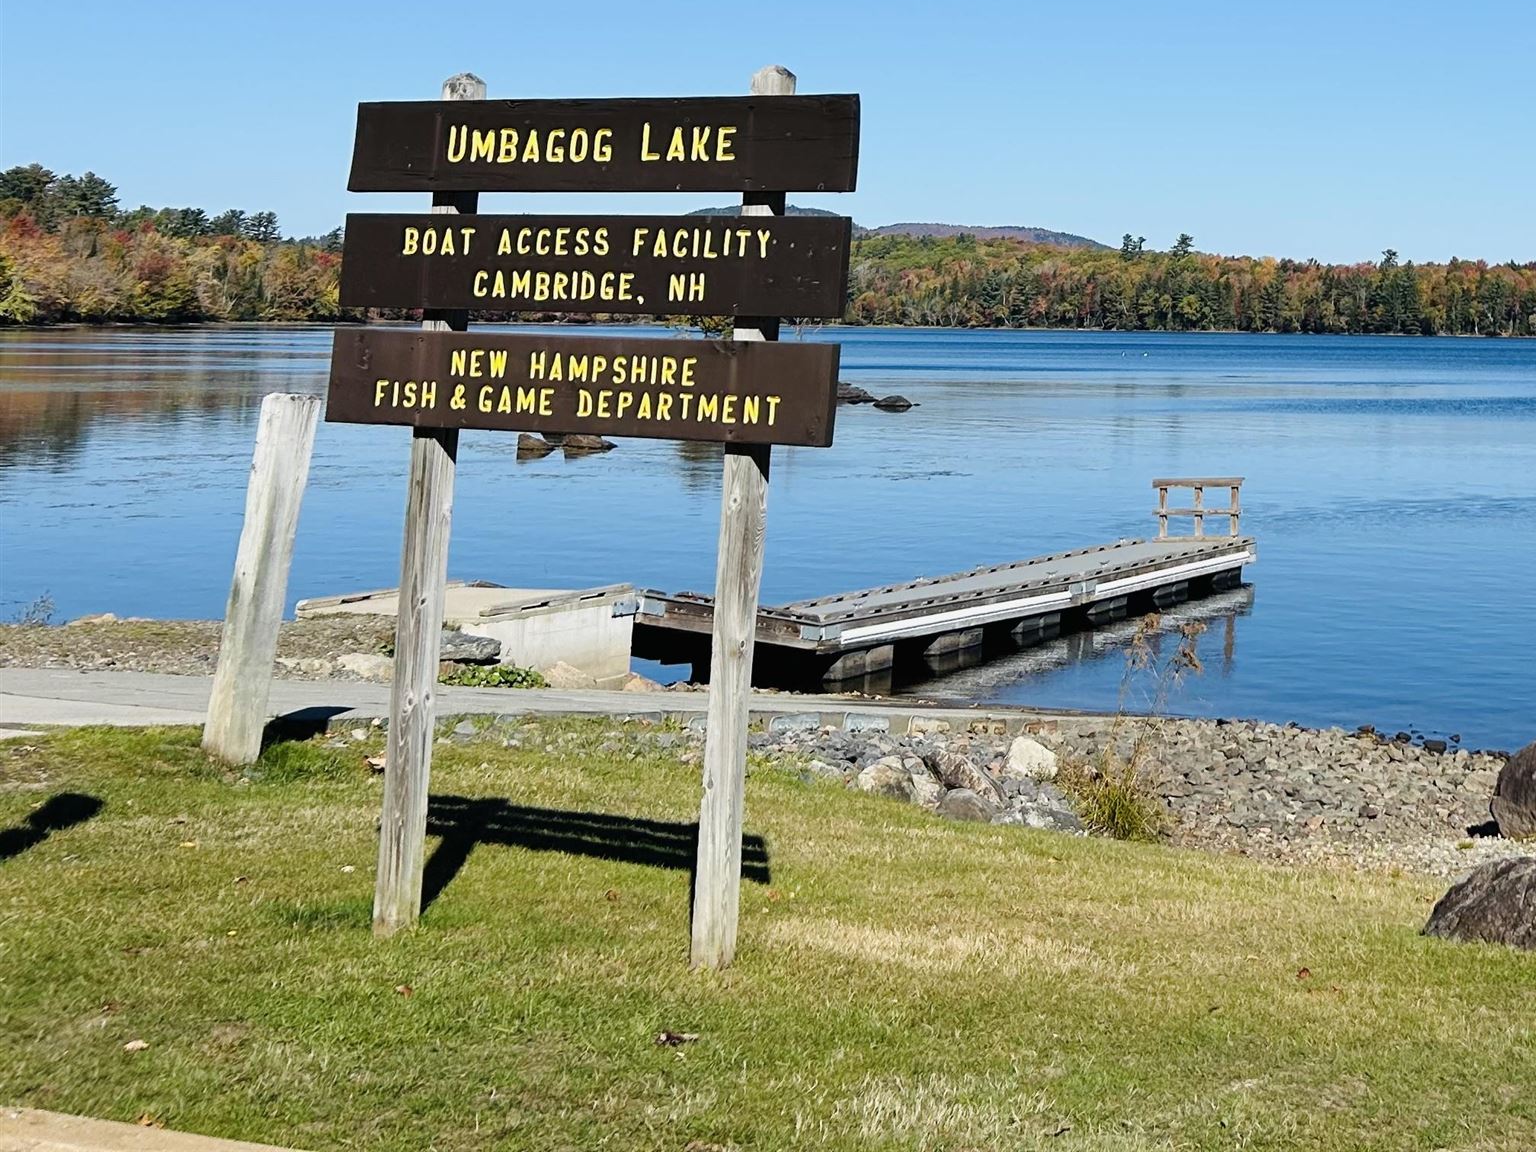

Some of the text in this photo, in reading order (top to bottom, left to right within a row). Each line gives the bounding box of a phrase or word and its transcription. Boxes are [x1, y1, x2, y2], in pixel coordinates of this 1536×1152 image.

[446, 122, 738, 164] UMBAGOG LAKE
[401, 227, 771, 259] BOAT ACCESS FACILITY
[472, 270, 705, 304] CAMBRIDGE, NH
[450, 349, 698, 387] NEW HAMPSHIRE
[374, 379, 782, 426] FISH & GAME DEPARTMENT
